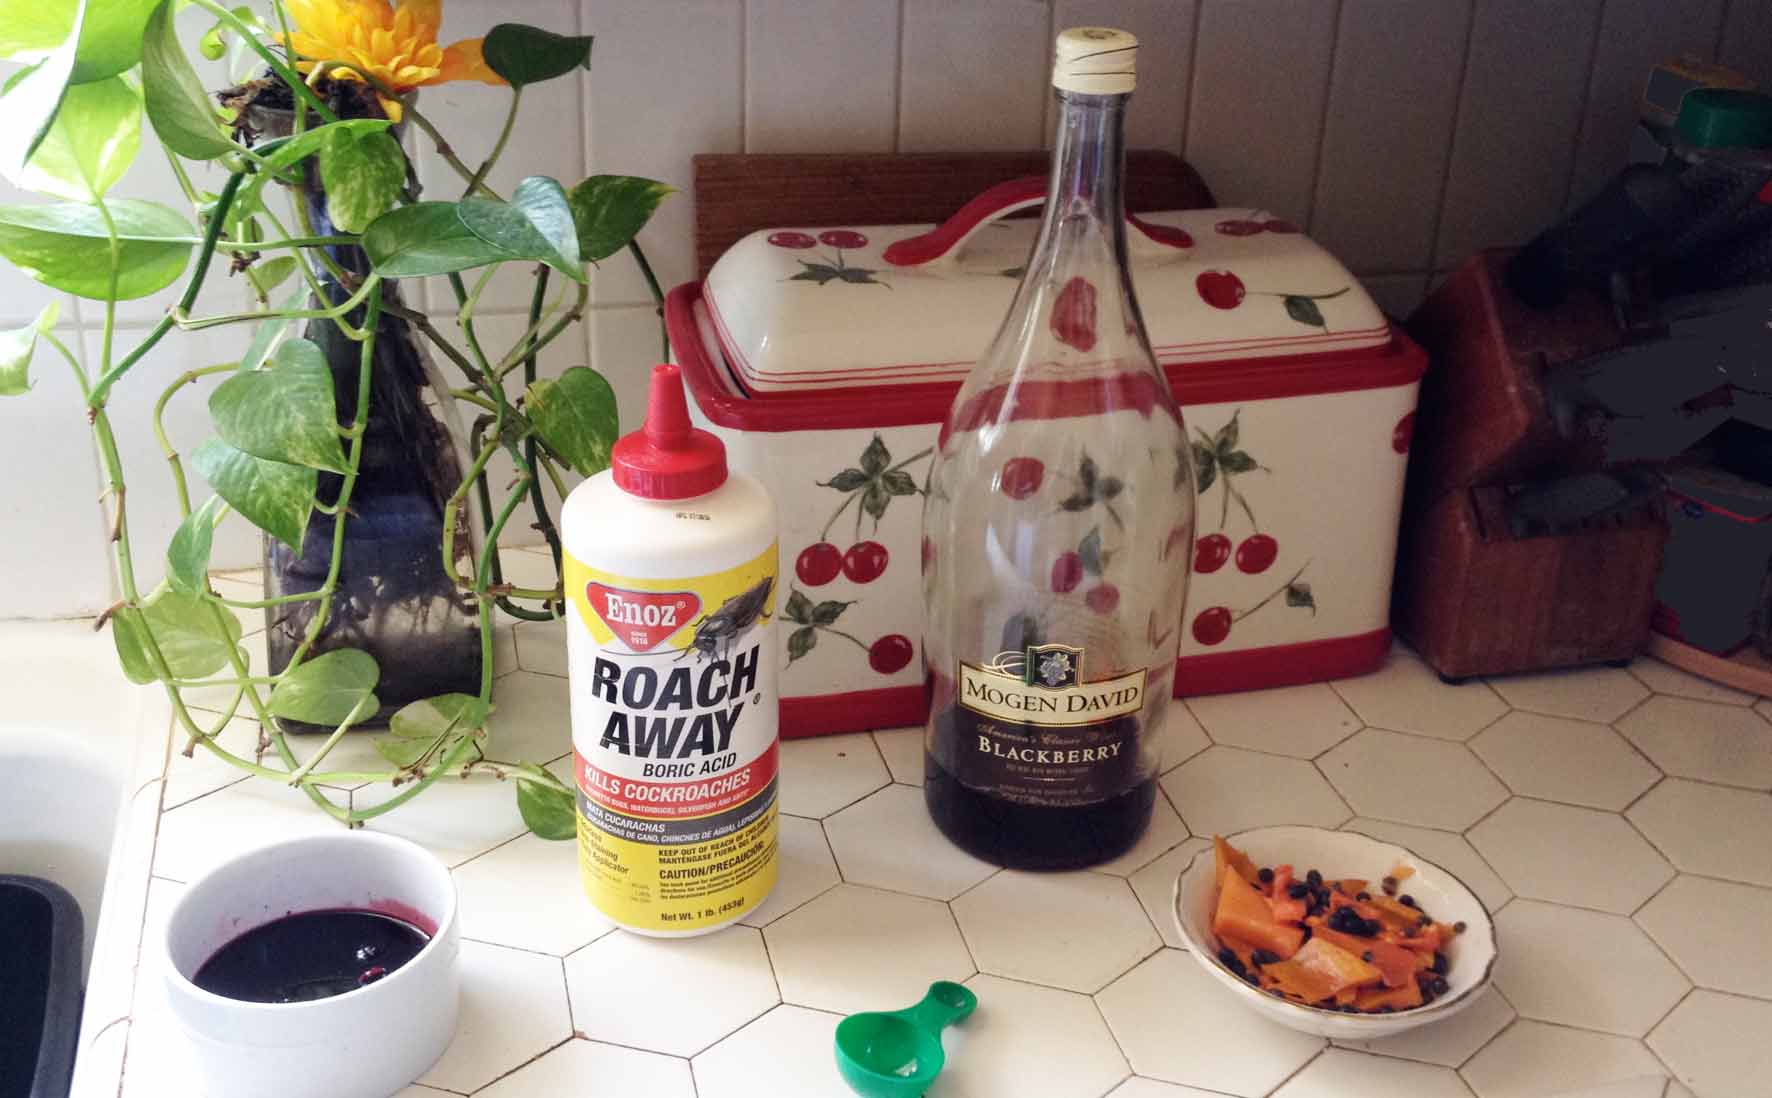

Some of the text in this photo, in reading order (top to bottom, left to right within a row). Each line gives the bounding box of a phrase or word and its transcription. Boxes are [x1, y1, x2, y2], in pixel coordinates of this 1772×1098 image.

[592, 644, 760, 711] ROACH
[966, 677, 1138, 713] MOGEN DAVID
[600, 701, 746, 760] AWAY
[643, 752, 737, 778] BORIC ACID
[978, 735, 1122, 764] BLACKBERRY
[584, 766, 621, 795] KILLS
[624, 768, 751, 802] COCKROACHES
[586, 799, 603, 819] MATA
[604, 812, 665, 833] CUCARACHAS
[659, 848, 679, 857] KEEP
[681, 848, 696, 857] OUT
[698, 845, 708, 854] OF
[661, 912, 677, 921] Net
